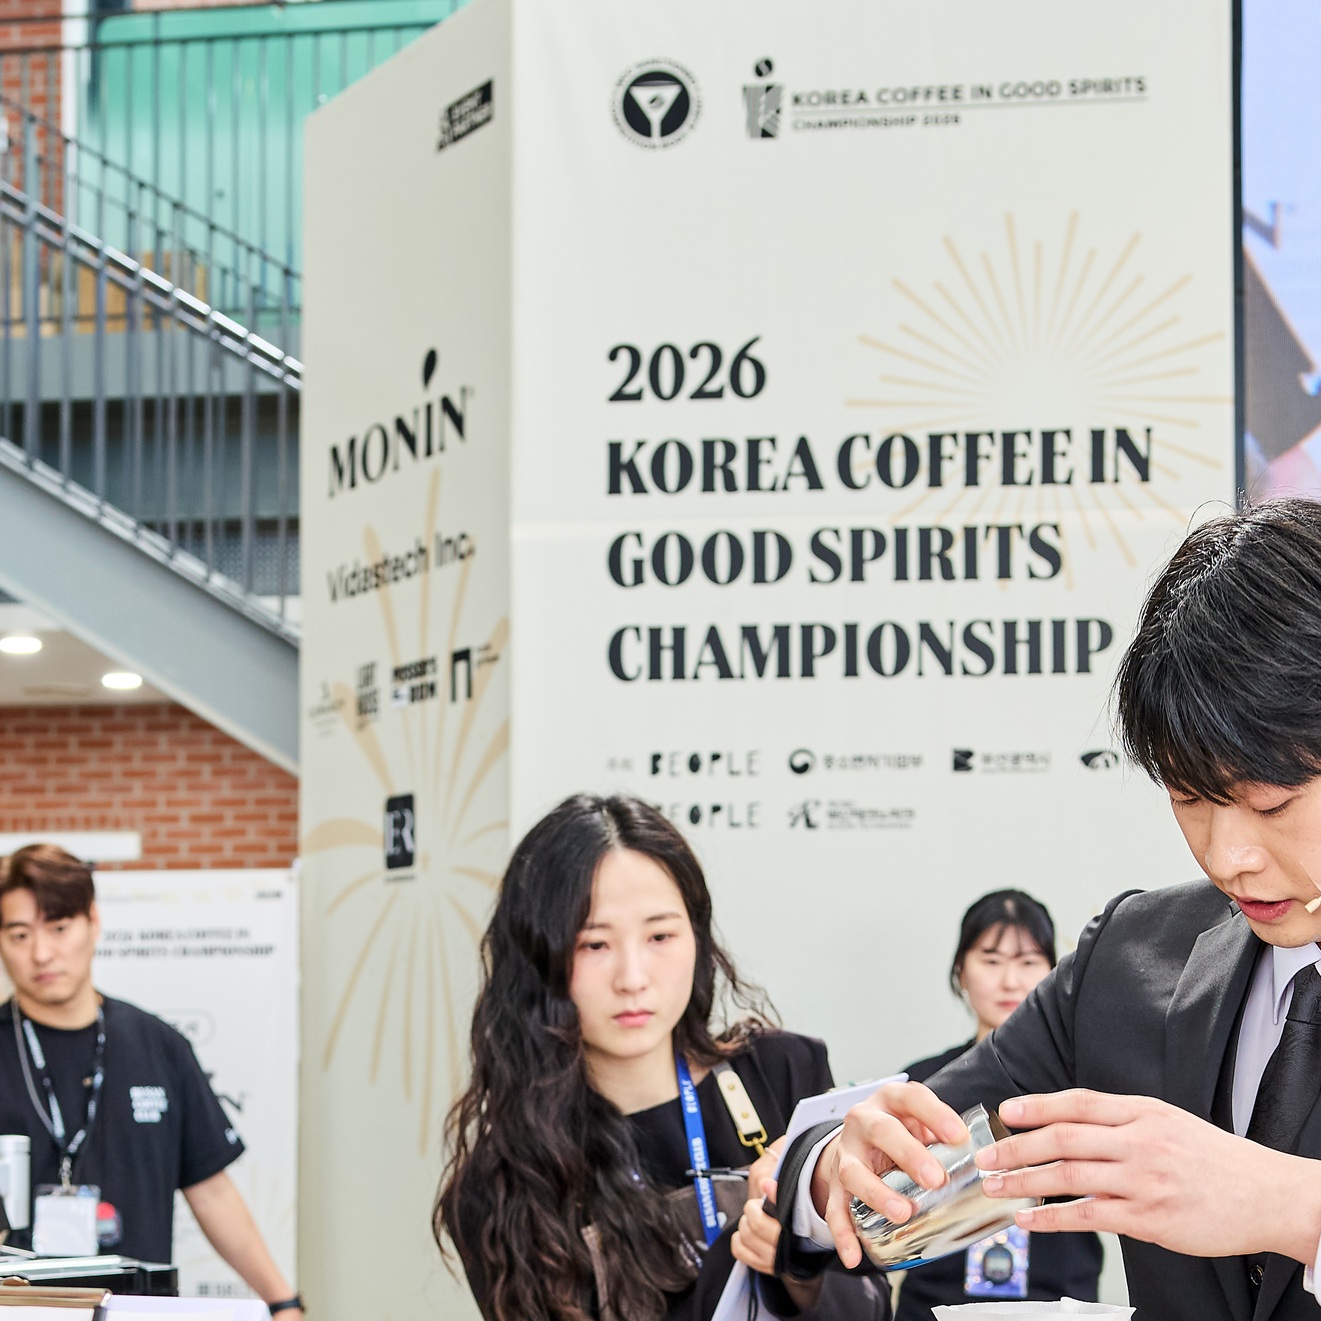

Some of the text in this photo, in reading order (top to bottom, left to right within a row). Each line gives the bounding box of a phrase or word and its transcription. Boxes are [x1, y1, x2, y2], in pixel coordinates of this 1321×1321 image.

[793, 76, 1146, 107] KOREA COFFEE IN GOOD SPIRITS
[793, 115, 917, 131] CHAMPIONSHIP
[607, 337, 767, 402] 2026
[328, 386, 469, 498] MONIN
[607, 427, 1152, 496] KOREA COFFEE IN
[327, 537, 430, 603] Vidastech
[607, 523, 1063, 588] GOOD SPIRITS
[607, 618, 1114, 683] CHAMPIONSHIP
